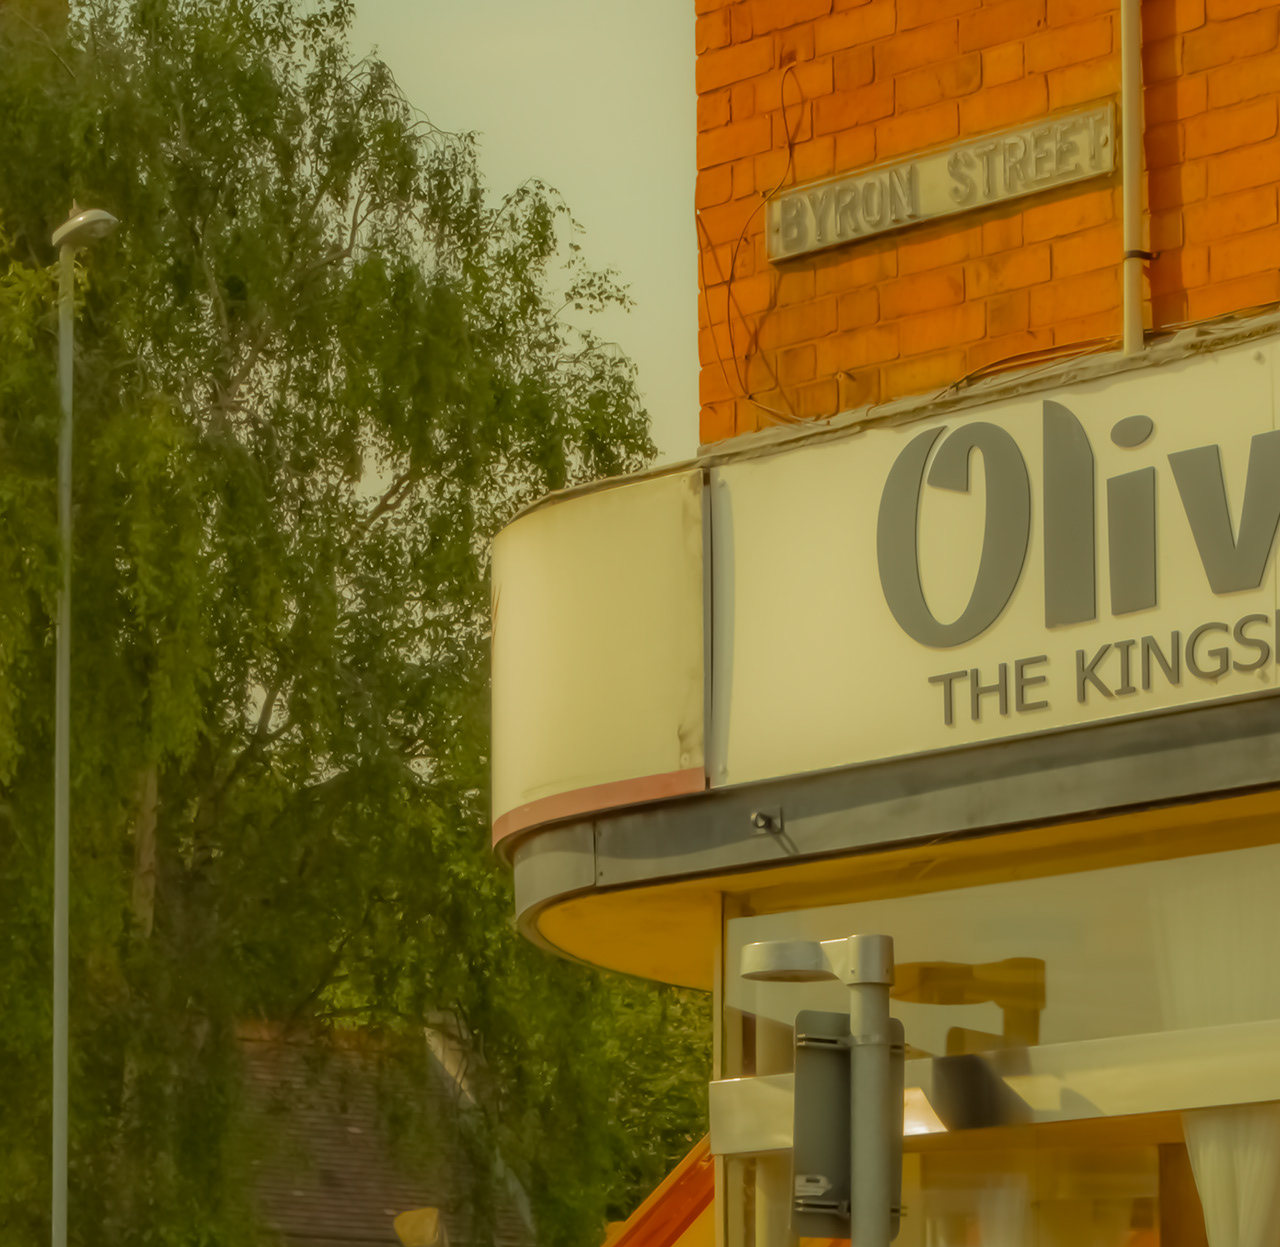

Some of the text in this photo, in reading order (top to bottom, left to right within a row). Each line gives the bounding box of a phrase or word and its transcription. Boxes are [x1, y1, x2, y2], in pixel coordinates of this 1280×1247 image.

[779, 112, 1105, 252] BYRON STREET
[928, 654, 1050, 725] THE
